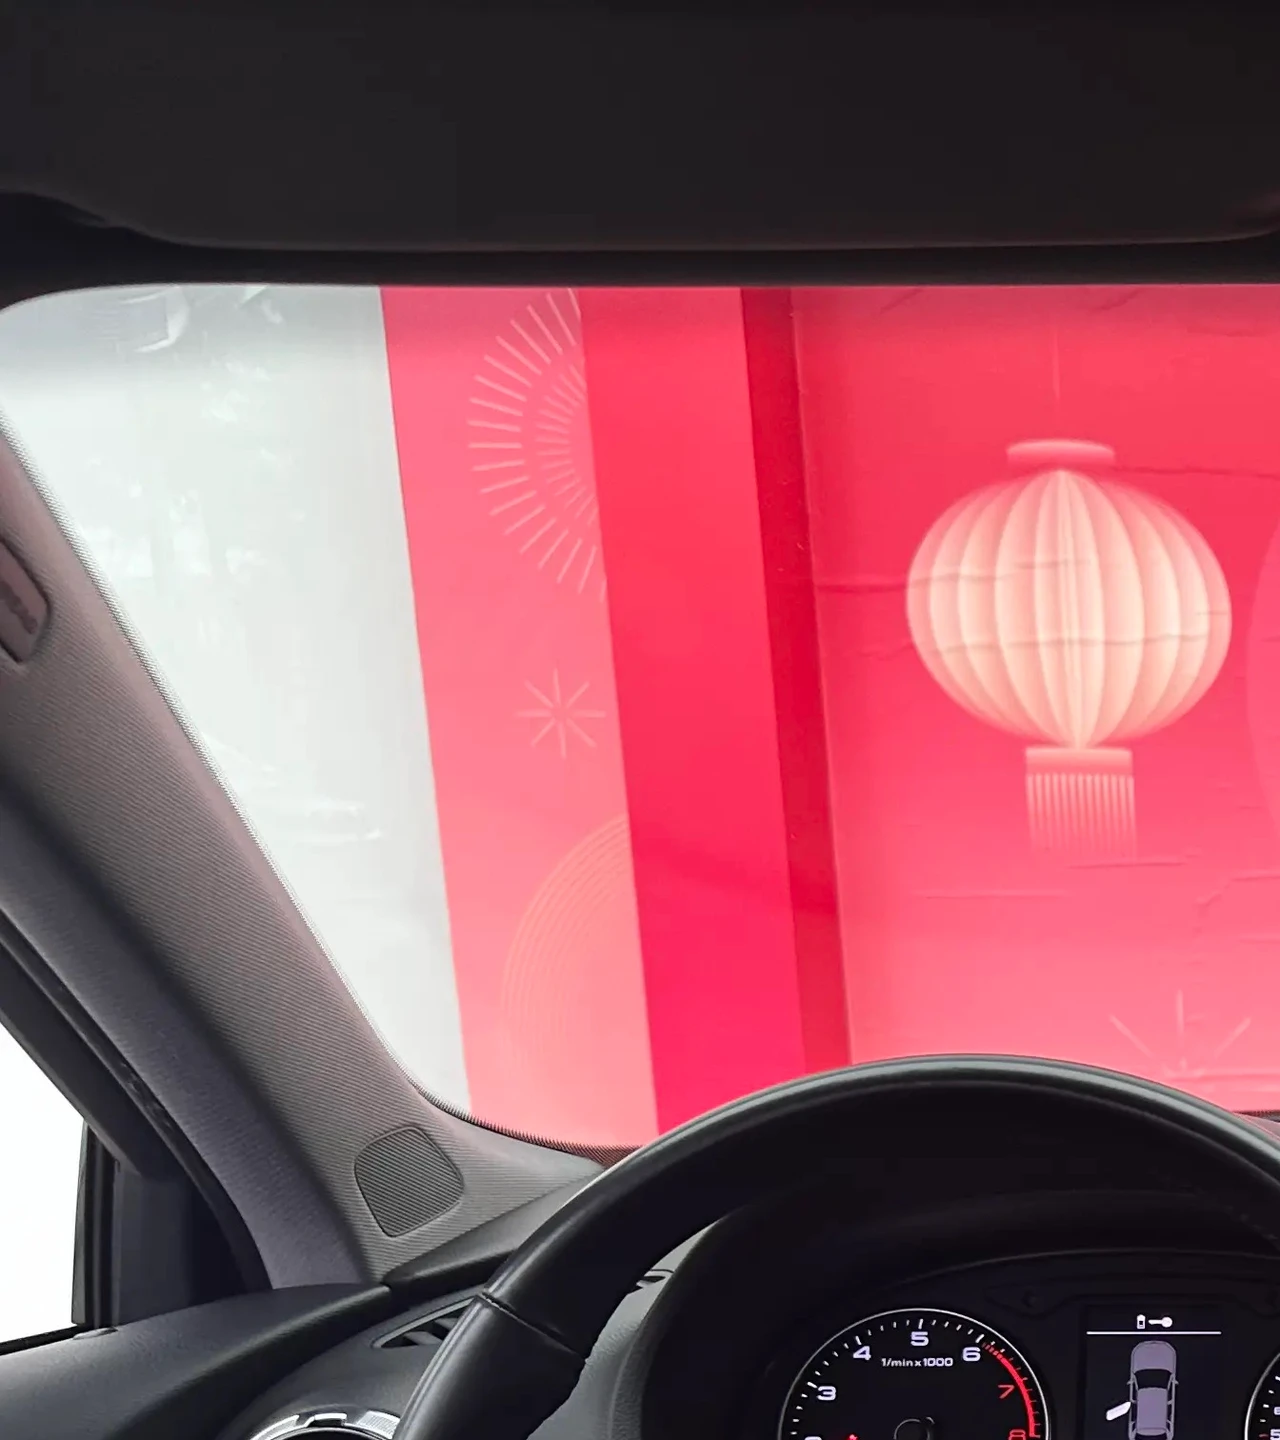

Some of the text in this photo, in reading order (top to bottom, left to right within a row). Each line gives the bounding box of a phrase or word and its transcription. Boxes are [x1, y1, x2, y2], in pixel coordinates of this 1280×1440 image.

[910, 1331, 929, 1346] 5
[853, 1345, 871, 1360] 4
[962, 1346, 981, 1361] 6
[817, 1386, 836, 1401] 3
[997, 1384, 1015, 1398] 7
